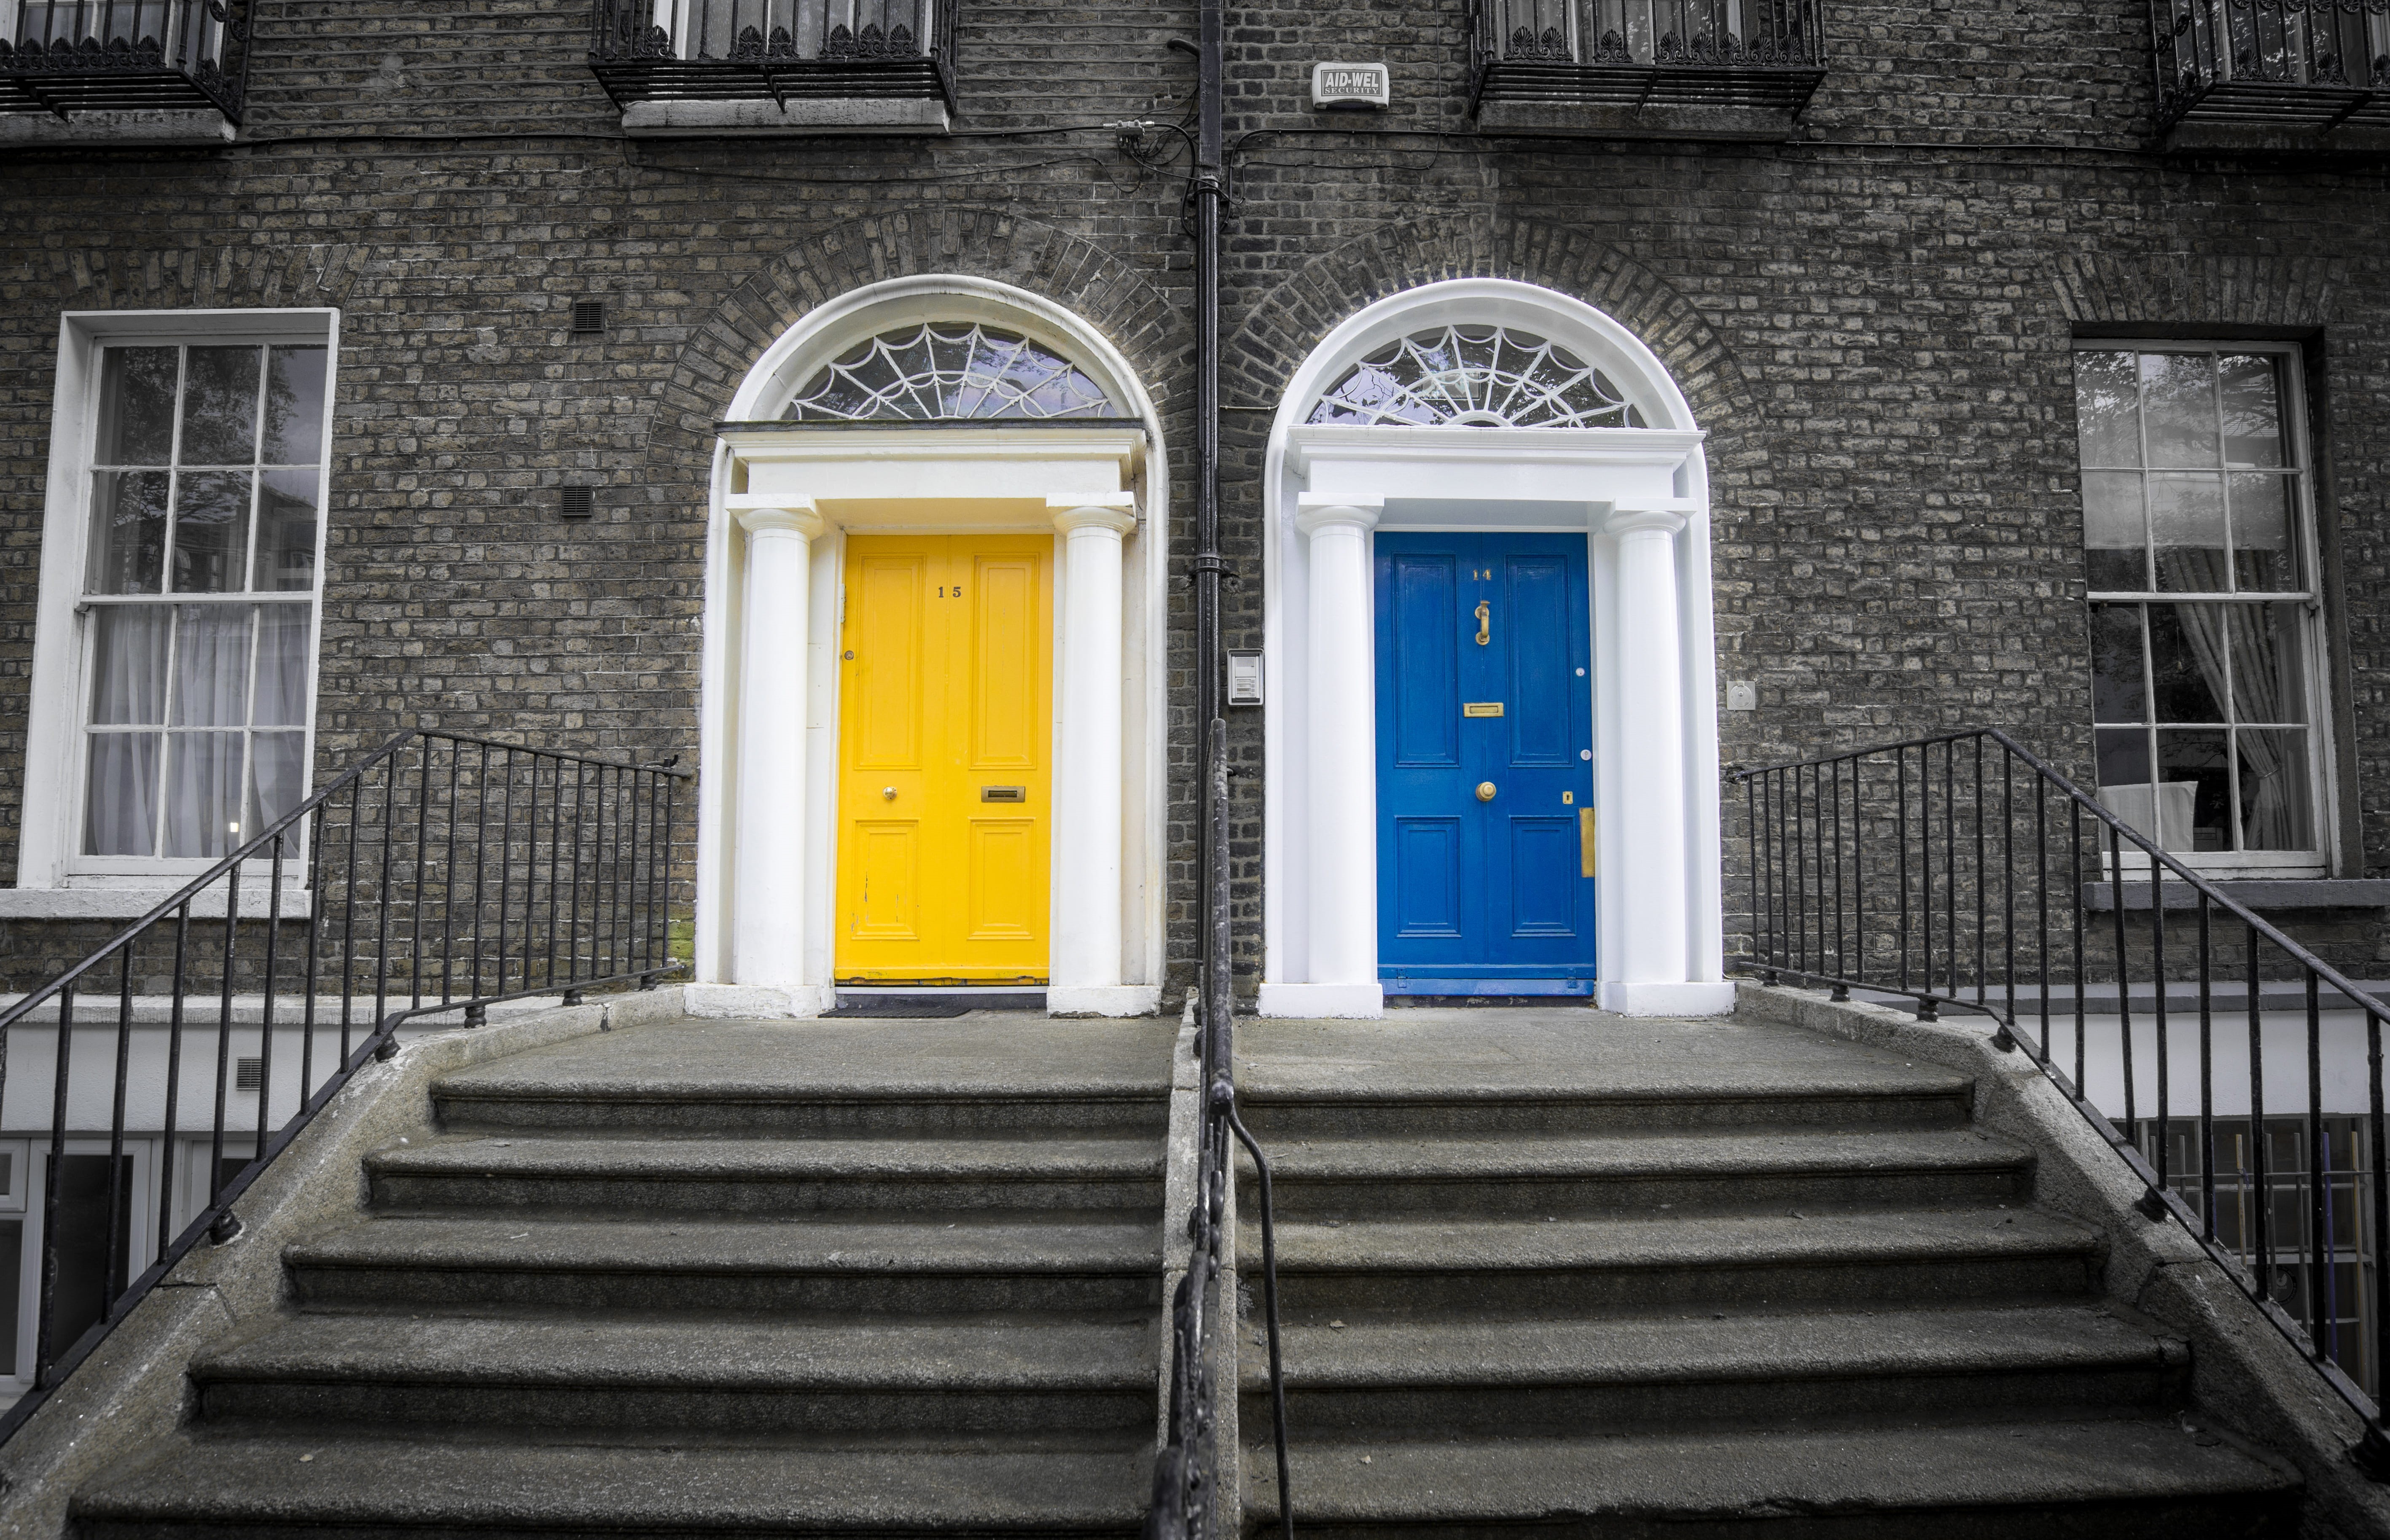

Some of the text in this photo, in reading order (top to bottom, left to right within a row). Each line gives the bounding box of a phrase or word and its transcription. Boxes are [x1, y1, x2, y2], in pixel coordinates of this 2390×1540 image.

[1325, 72, 1379, 87] AID-WEL
[1473, 569, 1492, 581] 14
[938, 586, 961, 598] 15
